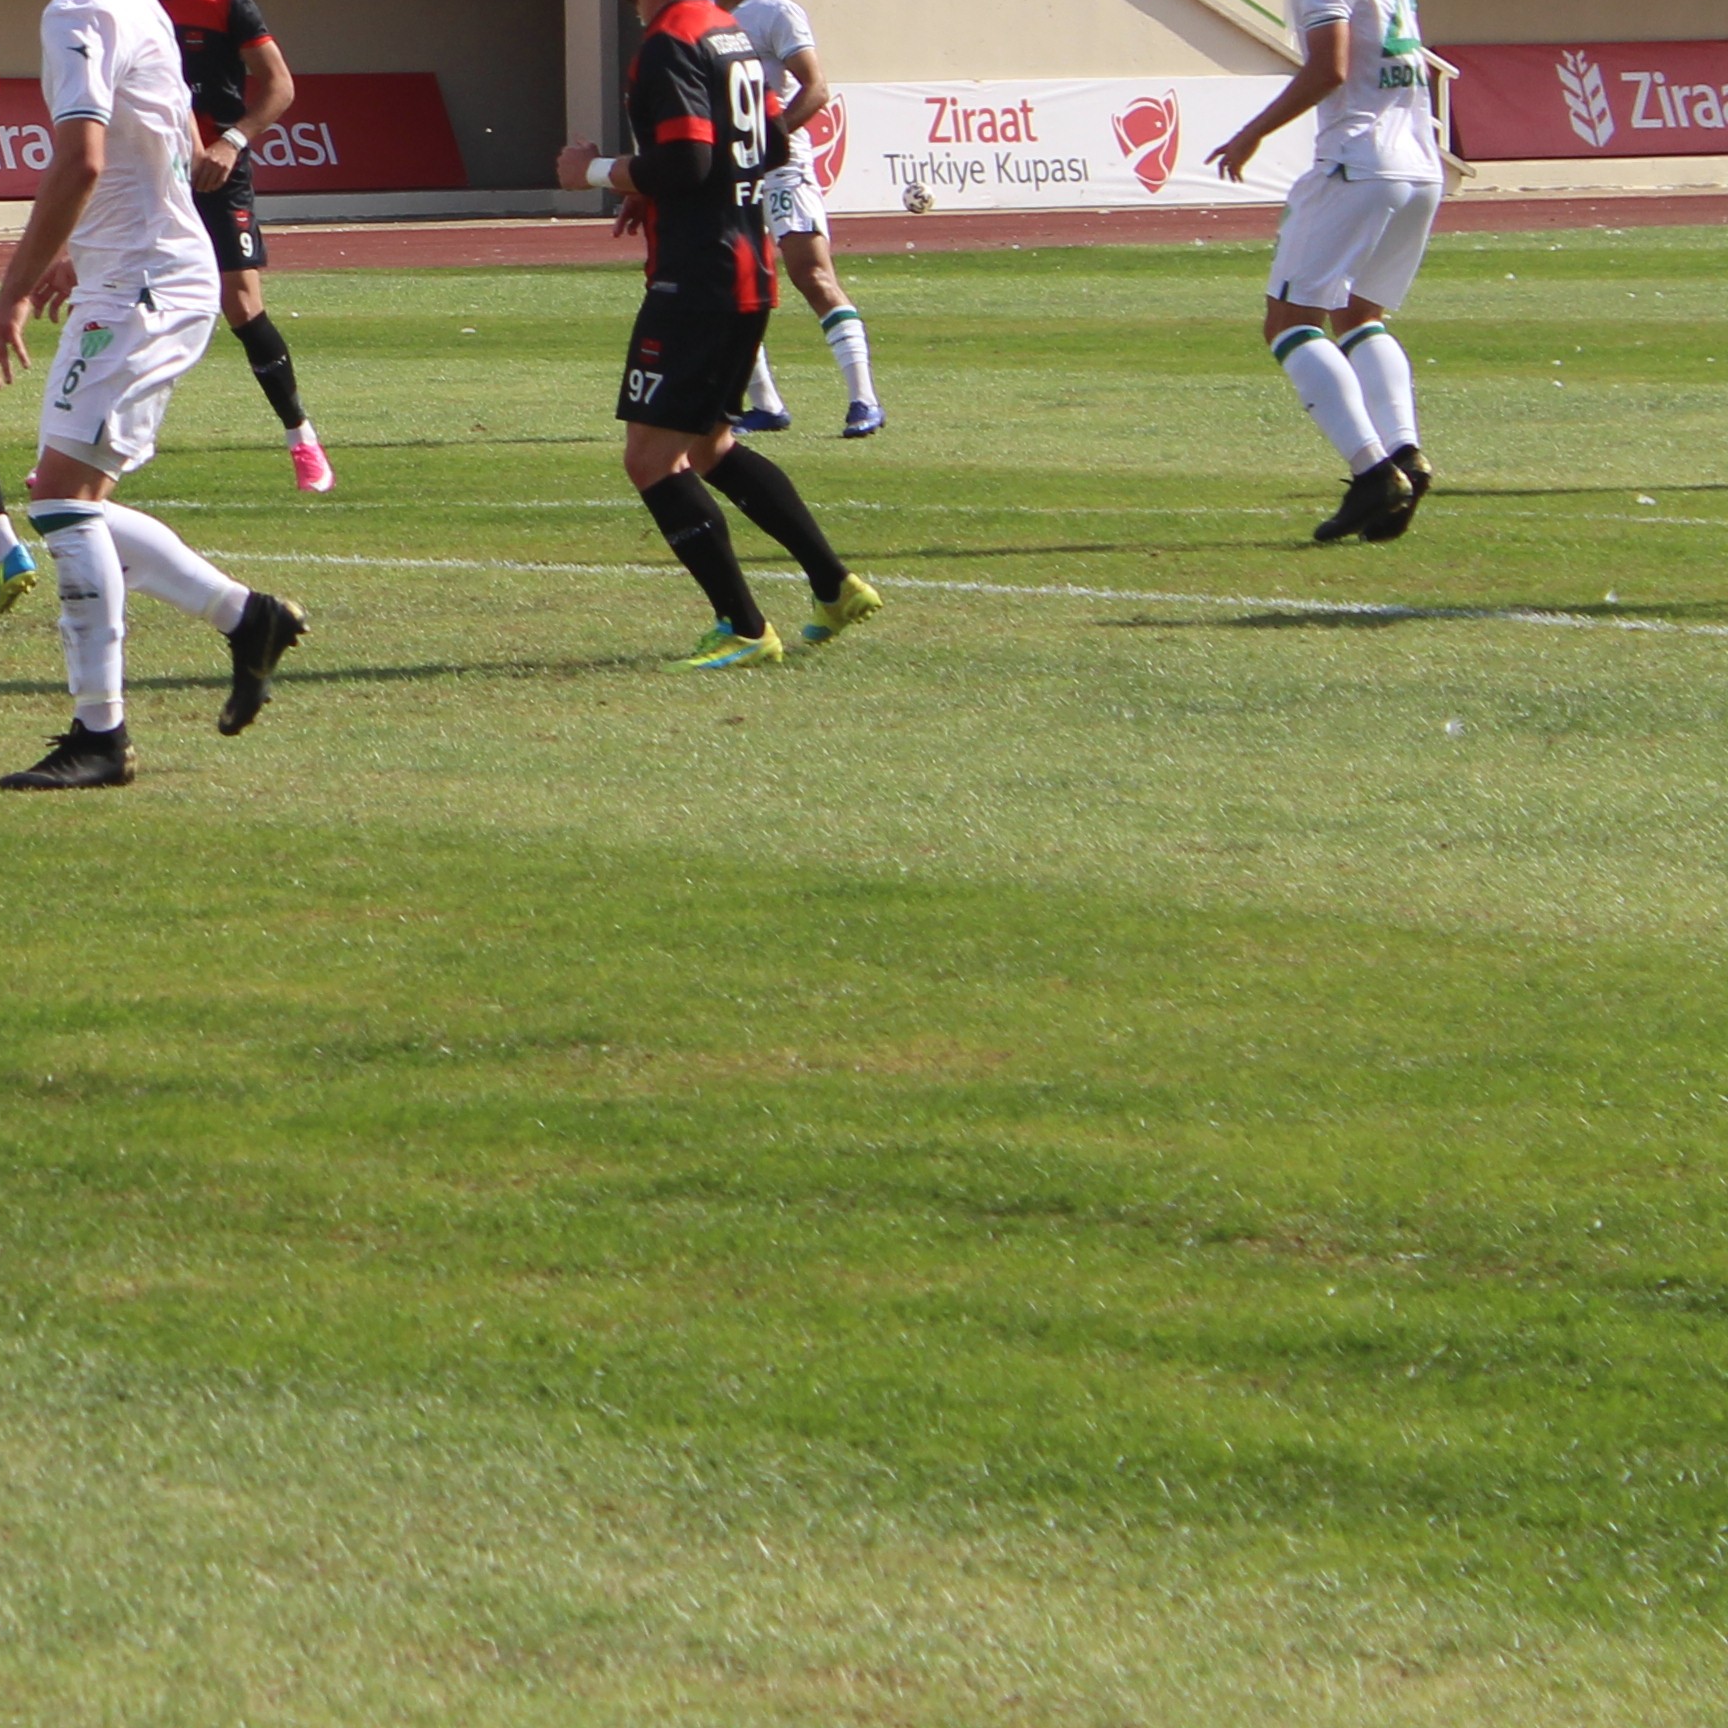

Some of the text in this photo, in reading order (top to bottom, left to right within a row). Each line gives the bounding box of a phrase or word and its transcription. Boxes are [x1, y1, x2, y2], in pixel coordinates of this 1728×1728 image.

[729, 59, 767, 169] 97
[924, 86, 1039, 144] Ziraat
[1620, 71, 1728, 129] Zira
[883, 152, 1089, 194] Türkiye Kupası
[770, 189, 793, 215] 26
[239, 232, 253, 258] 9
[62, 358, 87, 395] 6
[628, 368, 664, 405] 97
